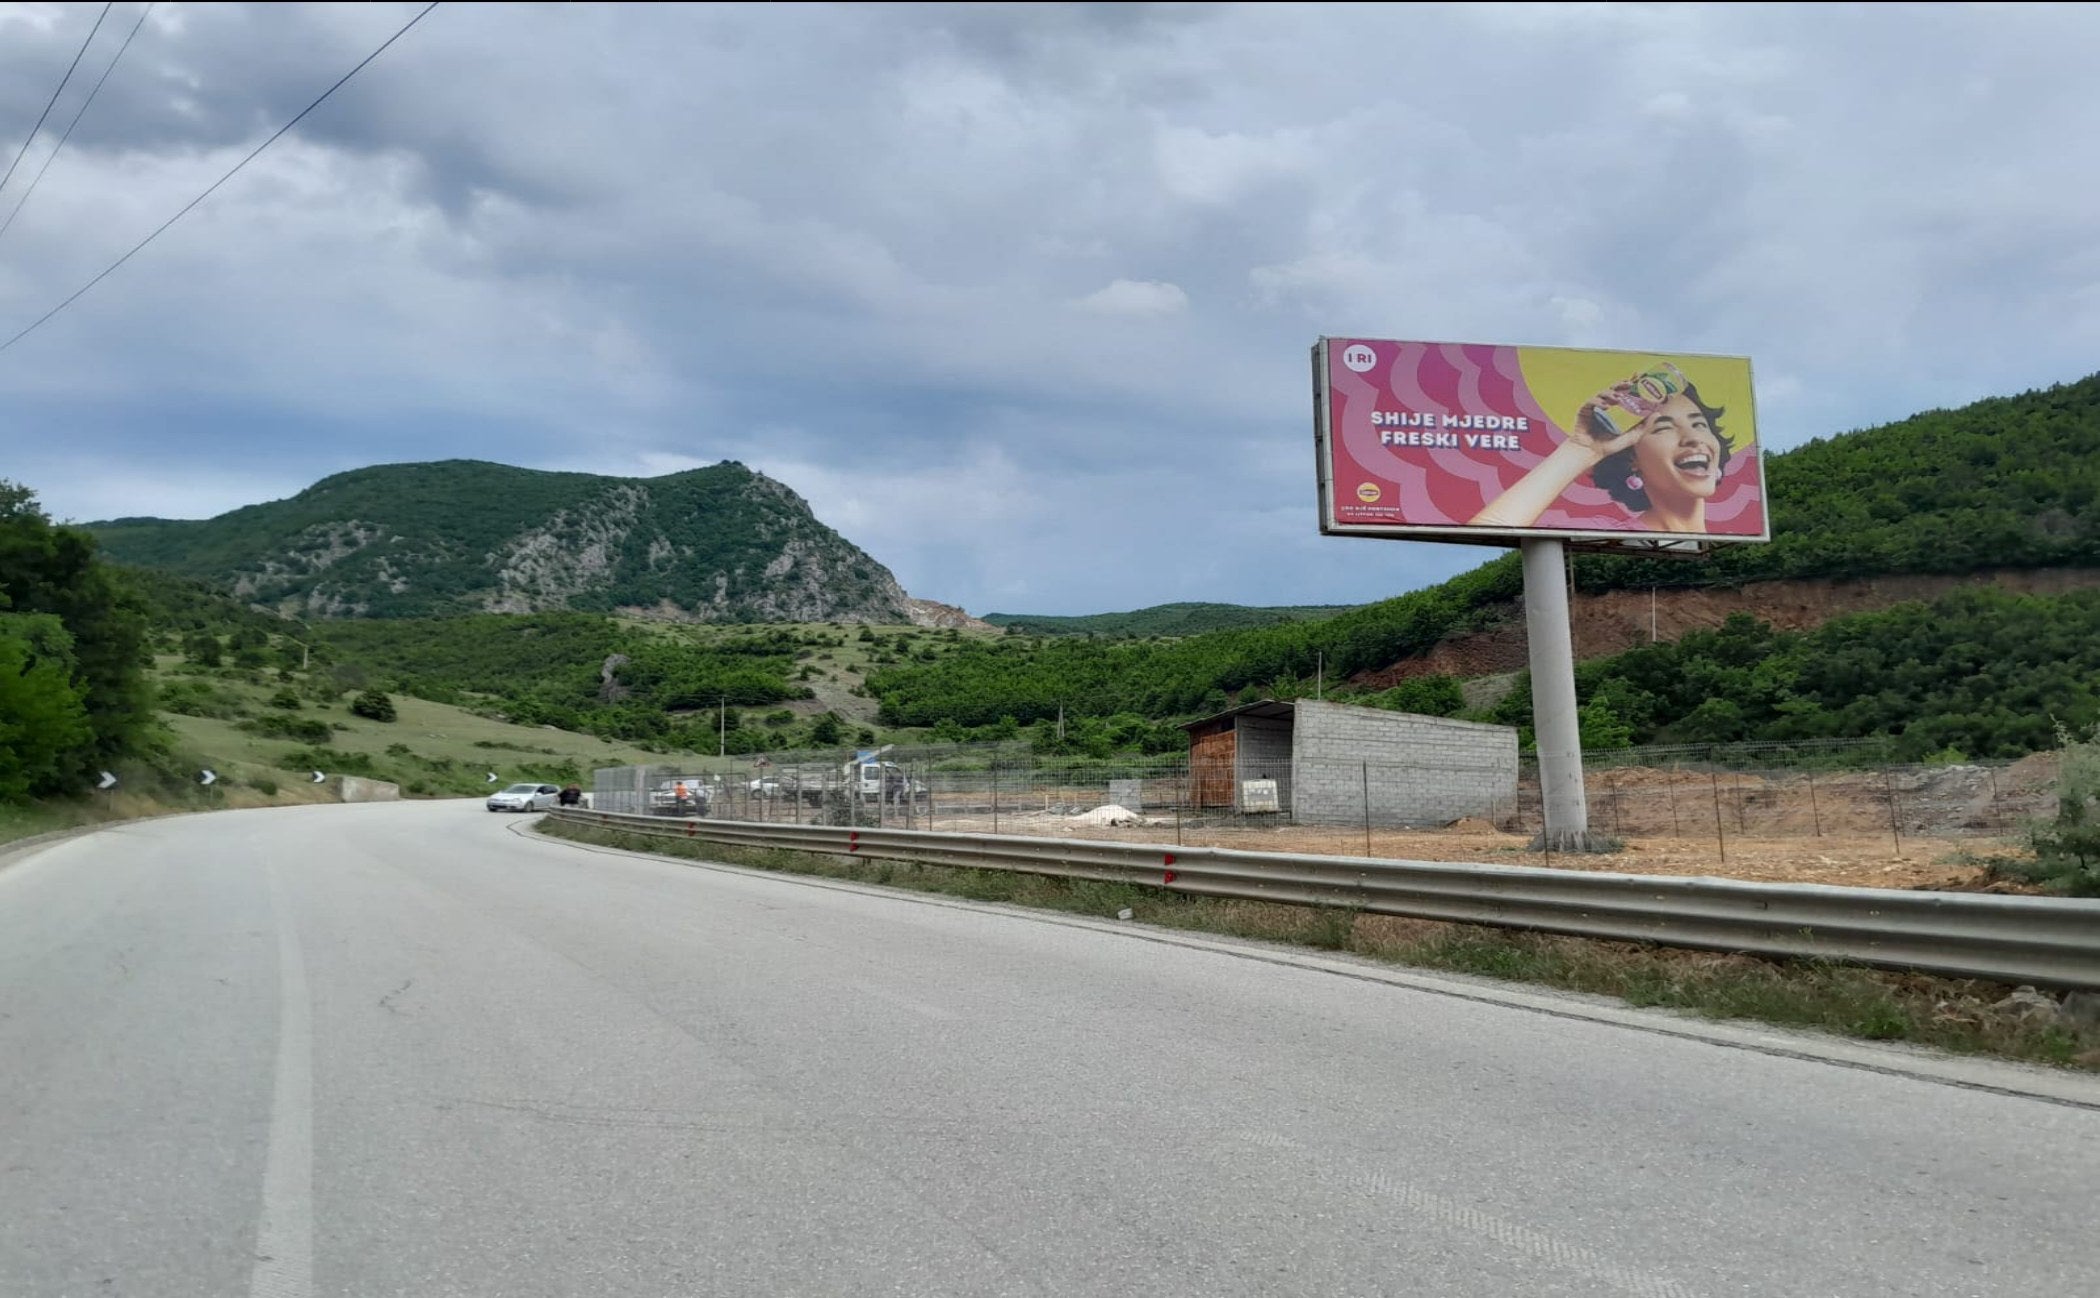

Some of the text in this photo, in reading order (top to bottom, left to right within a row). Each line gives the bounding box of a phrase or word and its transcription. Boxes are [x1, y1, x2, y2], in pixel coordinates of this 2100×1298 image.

[1357, 353, 1372, 363] RI
[1370, 411, 1528, 431] SHIJE MJEDRE
[1381, 431, 1520, 450] FRESKI VERE
